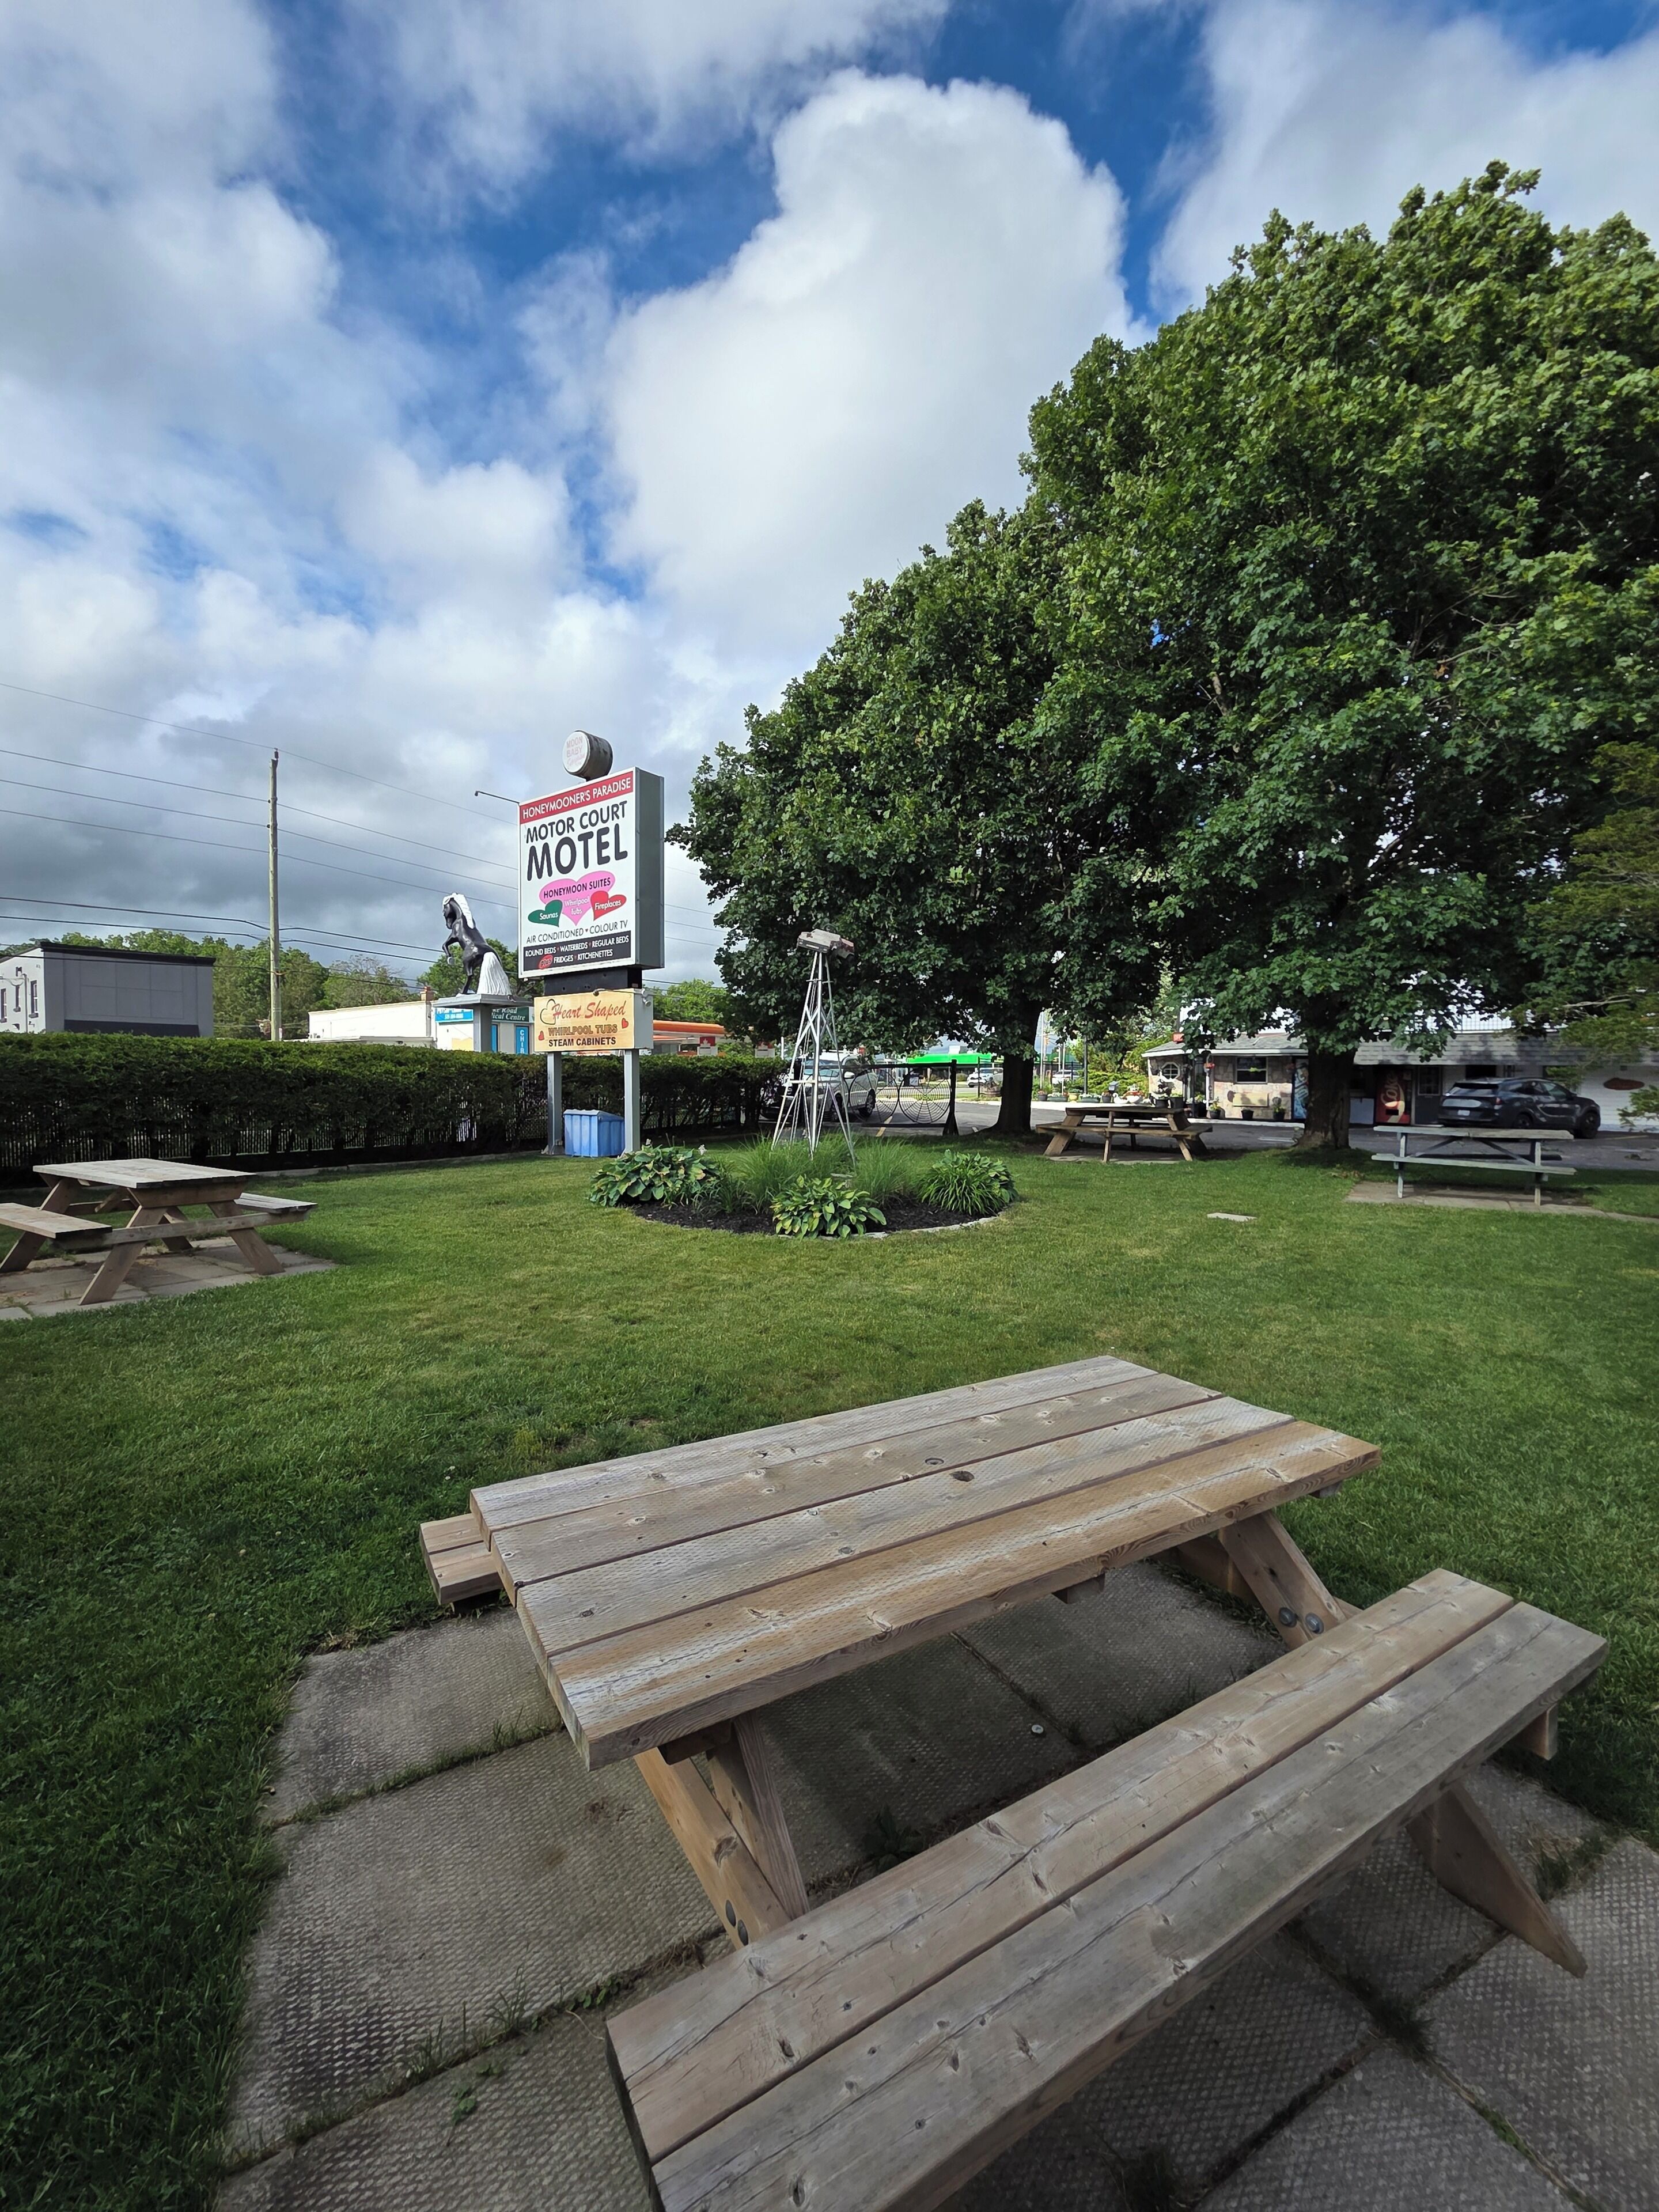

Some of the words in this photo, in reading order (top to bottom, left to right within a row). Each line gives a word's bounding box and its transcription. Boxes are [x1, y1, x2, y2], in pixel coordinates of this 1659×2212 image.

[522, 790, 590, 819] HONEYMOONER'S
[593, 778, 631, 799] PARADISE
[526, 817, 575, 843] MOTOR
[579, 801, 627, 830] COURT
[527, 823, 628, 881] MOTEL
[543, 883, 587, 899] HONEYMOON
[589, 877, 611, 890] SUITES
[565, 896, 589, 907] Whirlpool
[594, 900, 621, 911] Fireplaces
[539, 912, 558, 921] Saunas
[527, 935, 536, 944] AIR
[537, 928, 584, 942] CONDITIONED
[589, 922, 618, 934] COLOUR
[620, 920, 628, 929] TV
[525, 948, 543, 957] ROUND
[544, 946, 556, 955] BEDS
[560, 942, 588, 952] WATERBEDS
[592, 938, 615, 948] REGULAR
[616, 935, 629, 944] BEDS
[554, 955, 574, 964] FRIDGES
[577, 949, 613, 960] KITCHENETTES
[551, 1003, 581, 1020] Heart
[585, 1000, 626, 1021] Shaped
[548, 1025, 593, 1036] WHIRLPOOL
[595, 1024, 618, 1034] TUBS
[548, 1038, 574, 1047] STEAM
[576, 1037, 616, 1046] CABINETS
